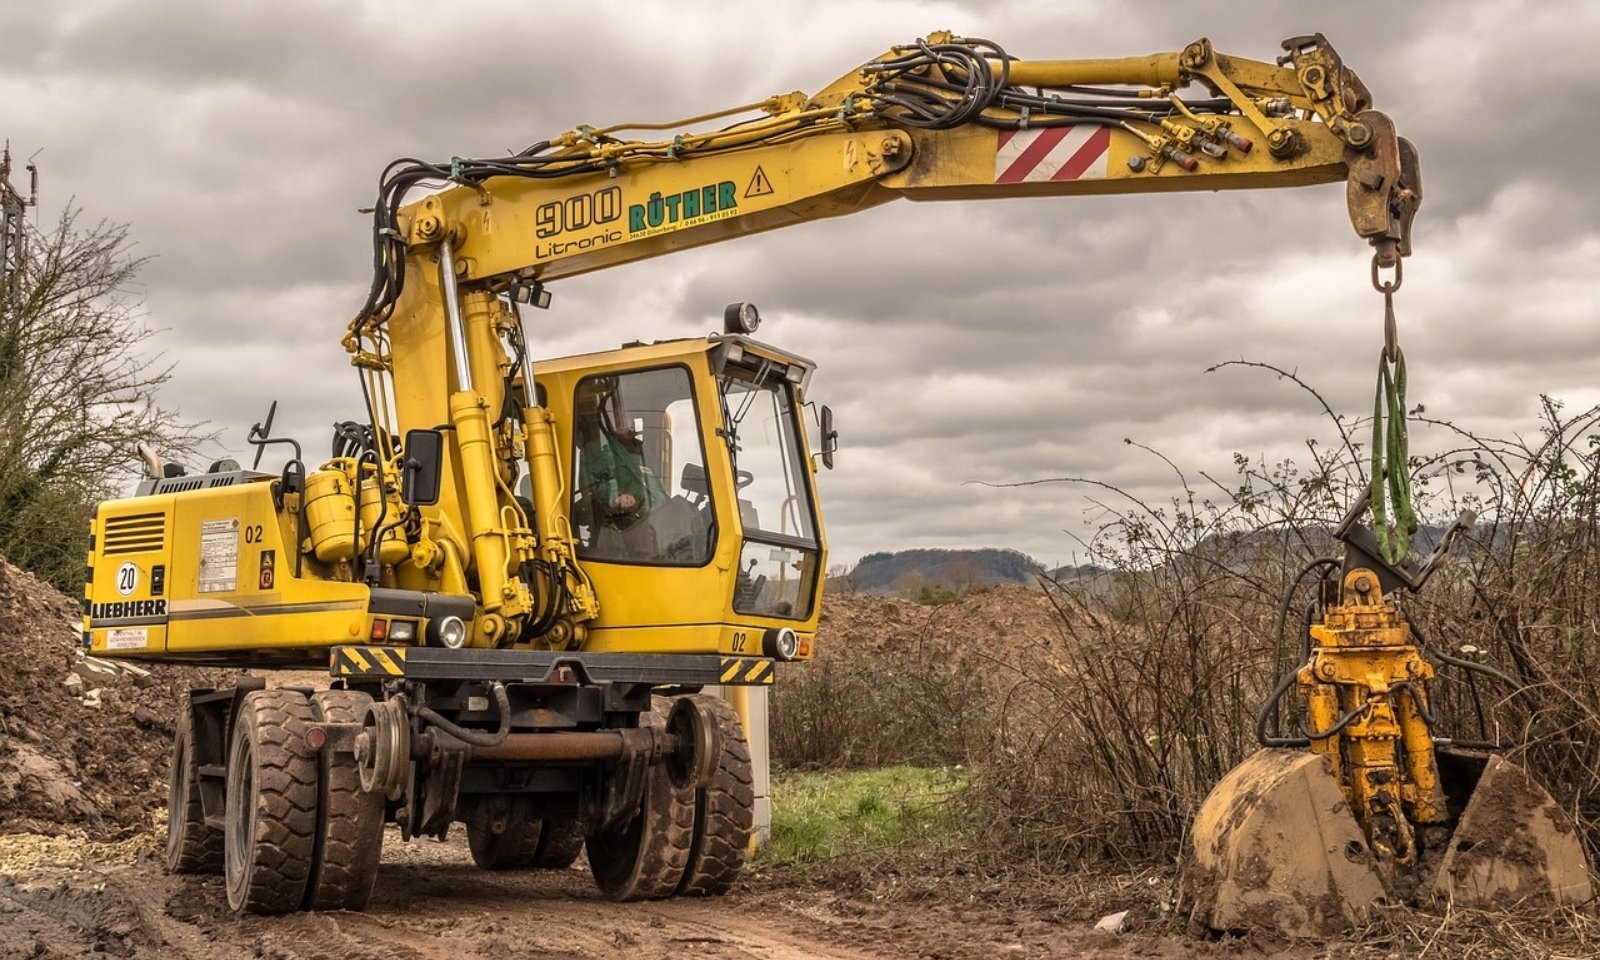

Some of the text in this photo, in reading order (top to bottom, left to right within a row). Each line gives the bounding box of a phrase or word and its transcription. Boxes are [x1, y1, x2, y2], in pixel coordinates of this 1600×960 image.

[535, 185, 622, 239] 900
[628, 180, 738, 233] RÜTHER
[535, 229, 622, 259] Litronic
[245, 525, 263, 544] 02
[120, 568, 135, 590] 20
[92, 599, 167, 619] LIEBHERR
[732, 632, 746, 652] 02
